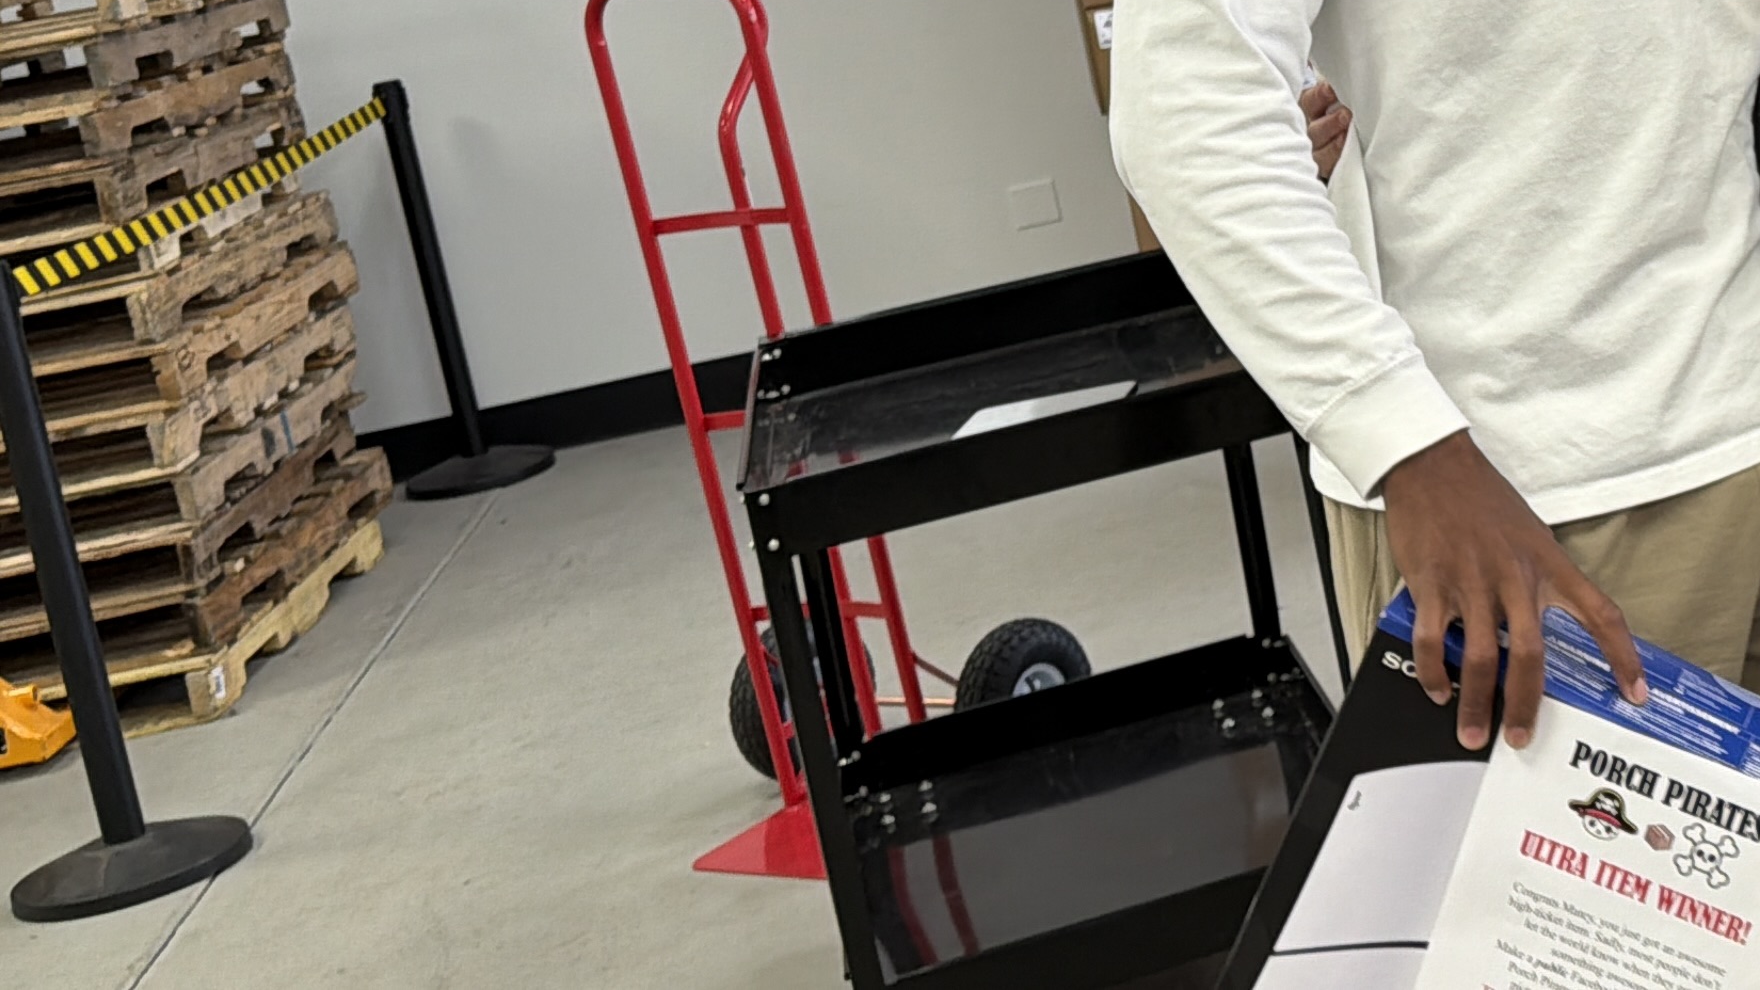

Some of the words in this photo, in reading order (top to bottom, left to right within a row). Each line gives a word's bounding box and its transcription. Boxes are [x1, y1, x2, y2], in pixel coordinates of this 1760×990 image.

[1570, 740, 1661, 799] PORCH
[1519, 830, 1589, 879] ULTRA
[1594, 859, 1652, 904] ITEM
[1658, 885, 1753, 946] WINNER!
[1677, 951, 1727, 977] awesome
